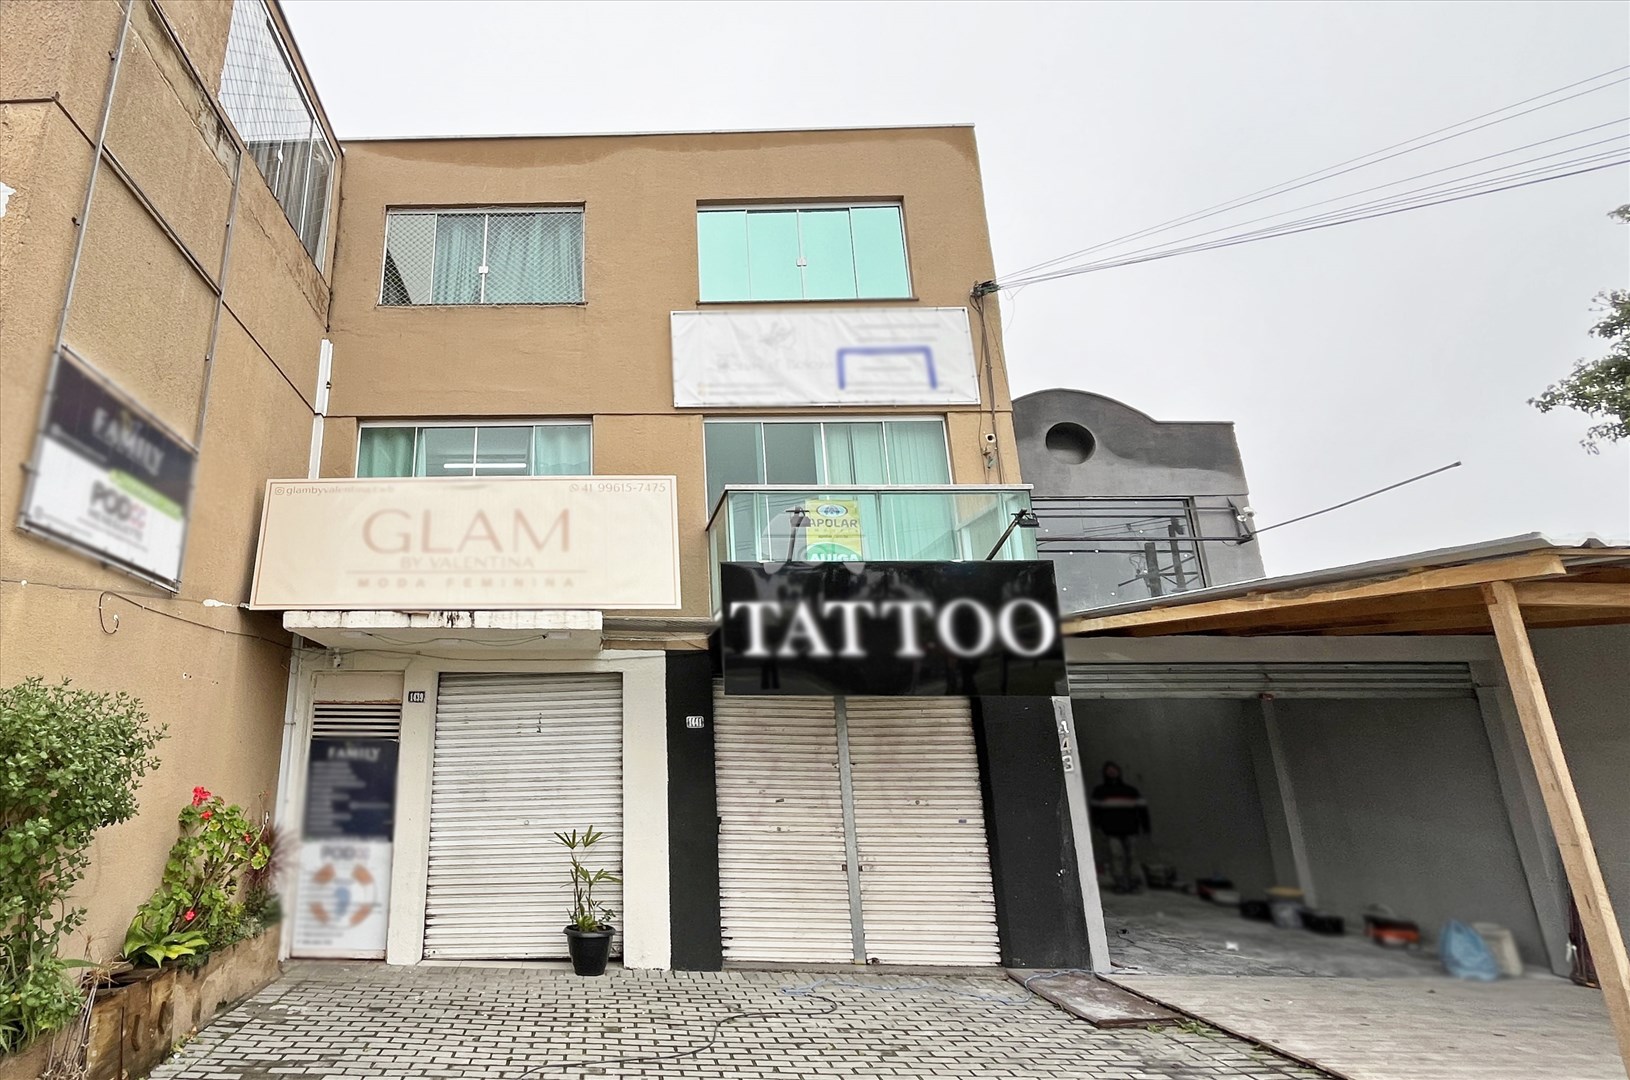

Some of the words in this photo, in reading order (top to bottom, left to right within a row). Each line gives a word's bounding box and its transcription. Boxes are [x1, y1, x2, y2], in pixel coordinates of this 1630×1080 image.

[582, 484, 593, 493] 41
[598, 483, 666, 493] 99615-7475
[810, 518, 858, 528] APOLAR
[362, 508, 570, 554] GLAM
[400, 557, 423, 569] BY
[429, 556, 535, 569] VALENTINA
[358, 578, 425, 588] MODA
[446, 577, 574, 588] FEMININA
[730, 598, 1055, 657] TATTOO
